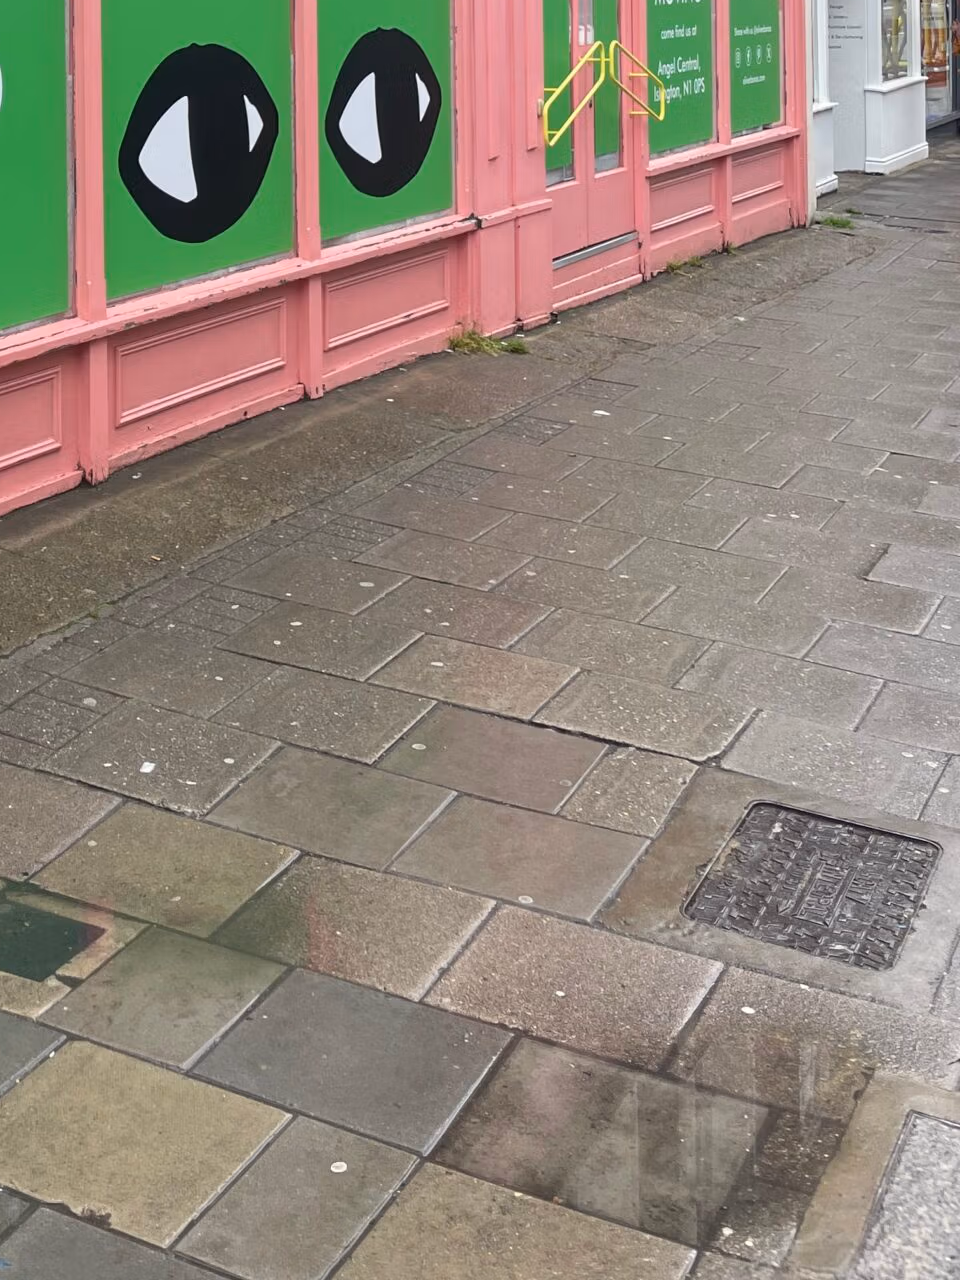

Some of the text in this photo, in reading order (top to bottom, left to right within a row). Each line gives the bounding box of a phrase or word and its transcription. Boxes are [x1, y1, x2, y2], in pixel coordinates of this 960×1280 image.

[657, 52, 701, 80] Angel Central,
[683, 79, 692, 97] N1
